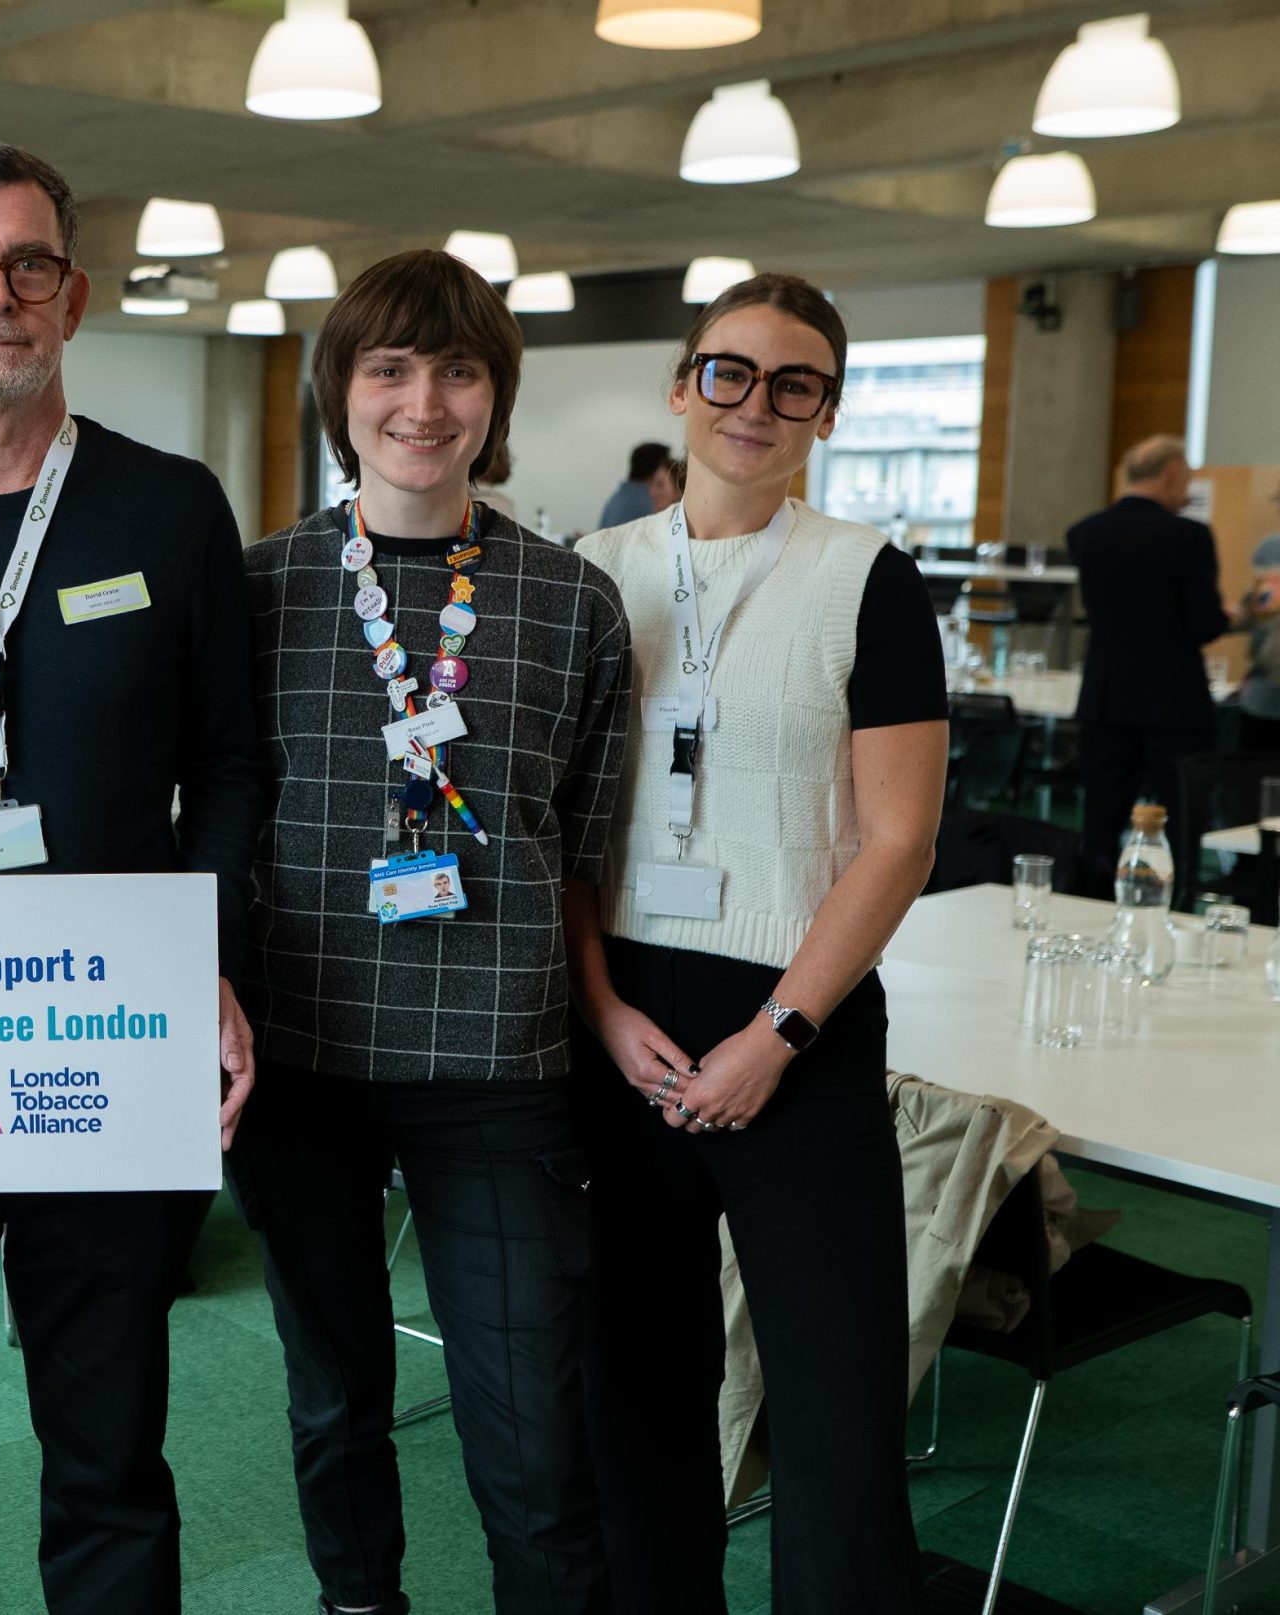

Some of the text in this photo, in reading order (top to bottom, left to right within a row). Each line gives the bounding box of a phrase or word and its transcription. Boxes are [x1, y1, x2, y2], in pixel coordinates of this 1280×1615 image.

[40, 468, 58, 505] Smoke Free
[10, 551, 29, 592] Smoke Free
[379, 649, 393, 669] Pride
[685, 638, 693, 659] Smoke
[418, 862, 437, 871] Service
[87, 955, 106, 981] a
[47, 1004, 167, 1041] London
[10, 1067, 100, 1088] London
[10, 1090, 109, 1111] Tobacco
[10, 1113, 102, 1135] Alliance
